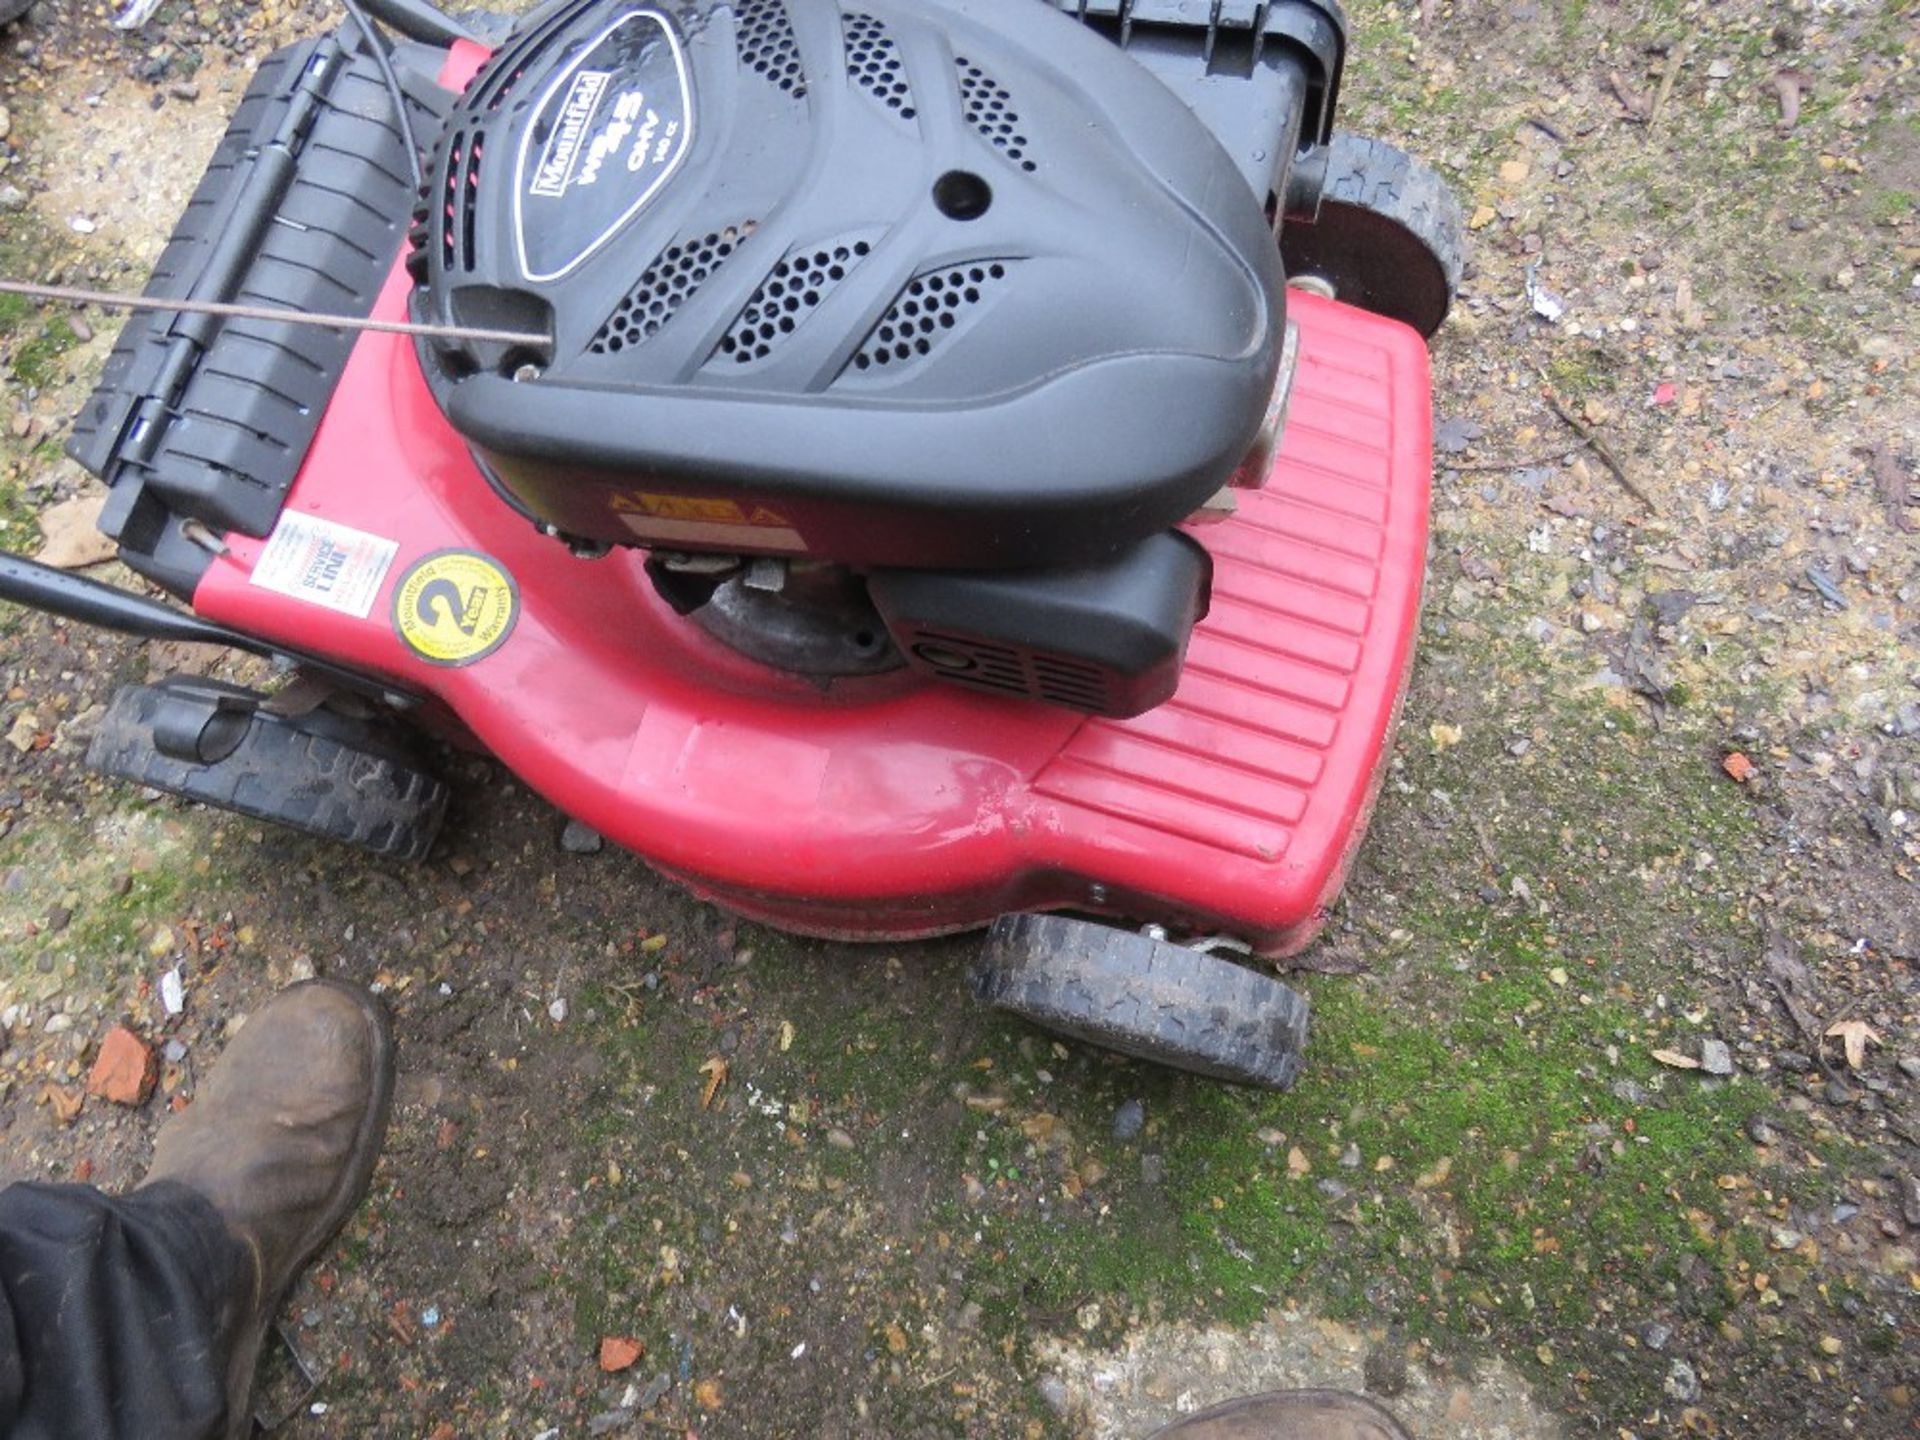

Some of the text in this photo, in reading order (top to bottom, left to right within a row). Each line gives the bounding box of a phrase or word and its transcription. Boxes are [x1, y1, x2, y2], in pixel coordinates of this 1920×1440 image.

[535, 76, 600, 188] Mountfield
[627, 109, 659, 172] OHV
[303, 535, 335, 588] SERVICE
[403, 566, 436, 632] Mountfield
[416, 579, 473, 637] 2
[461, 587, 487, 629] Year
[478, 586, 507, 641] Warranty
